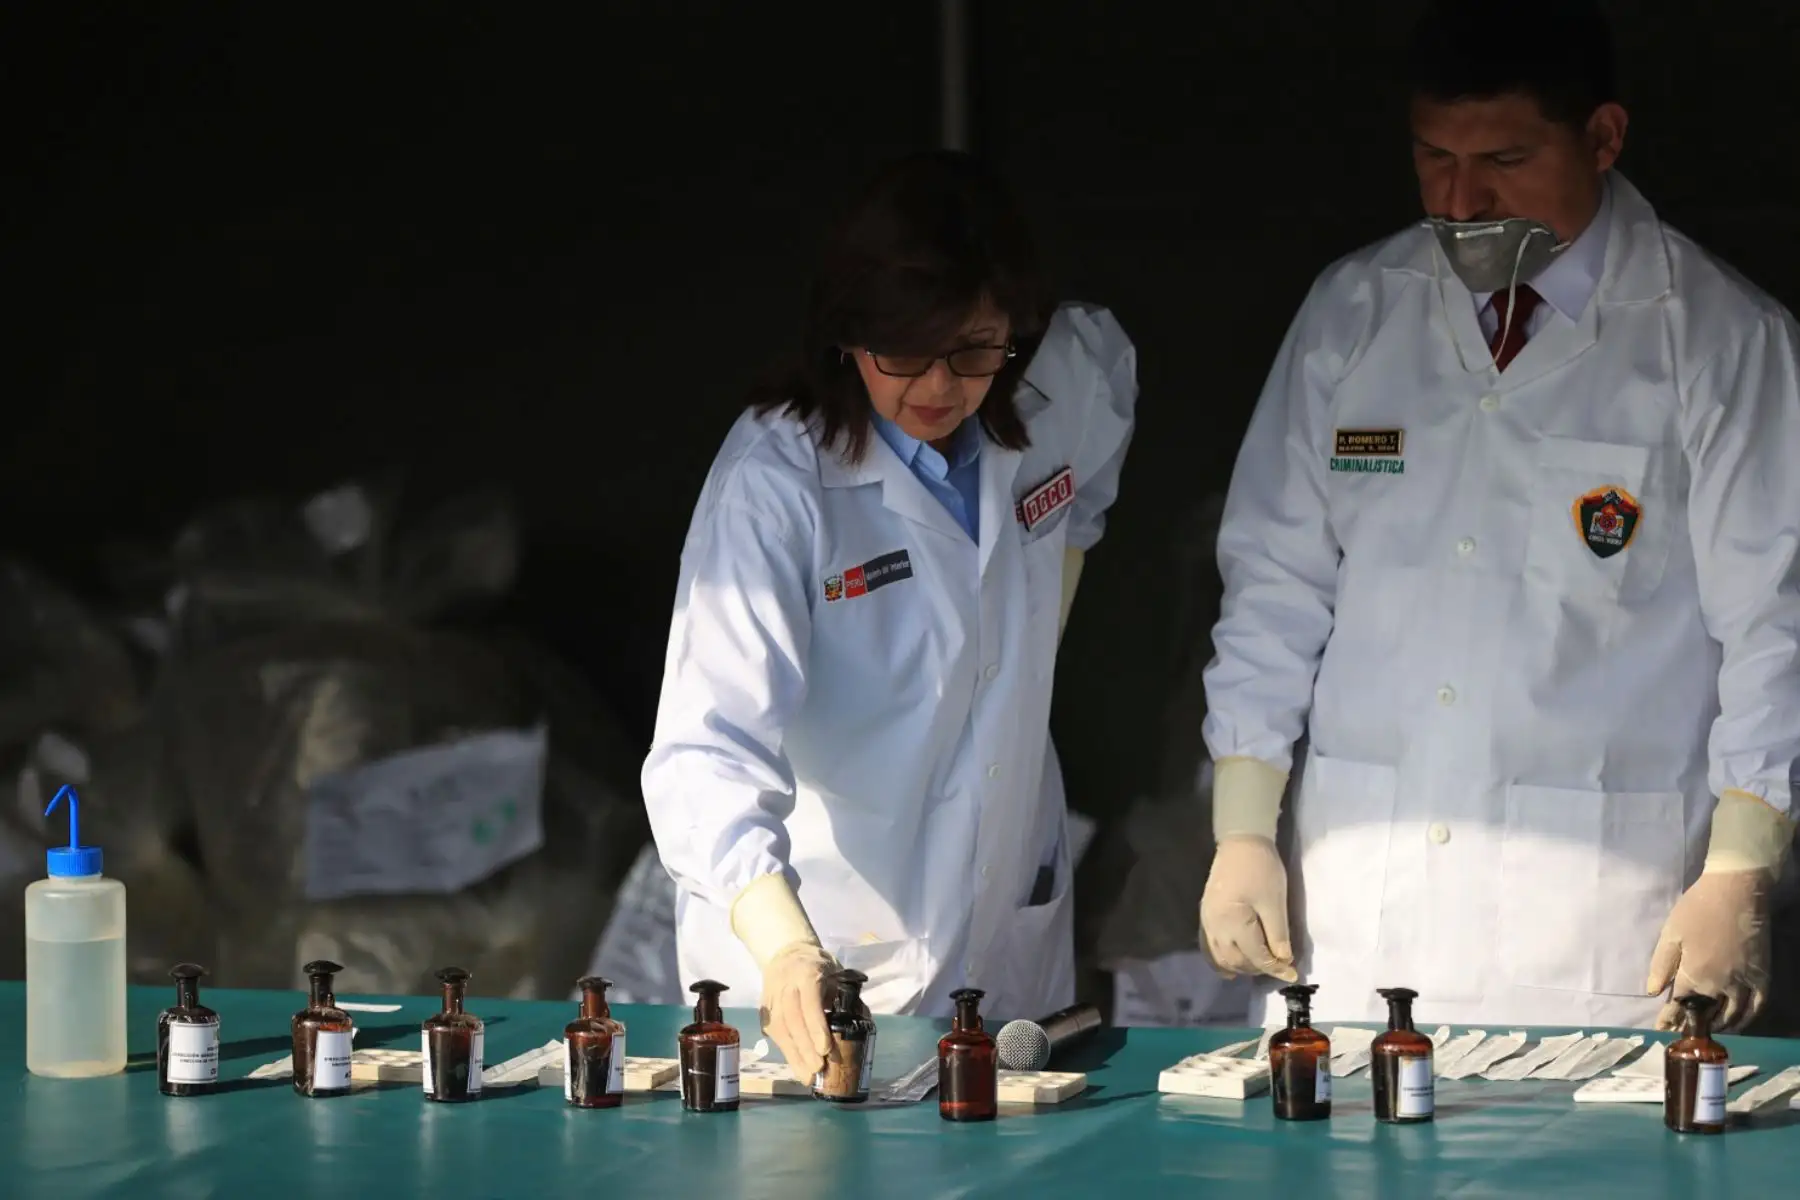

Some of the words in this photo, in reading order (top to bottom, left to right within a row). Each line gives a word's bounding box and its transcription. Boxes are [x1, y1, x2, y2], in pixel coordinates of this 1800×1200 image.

[1348, 435, 1388, 445] ROMERO
[1330, 457, 1405, 474] CRIMINALISTICA
[1028, 479, 1068, 521] DGCO
